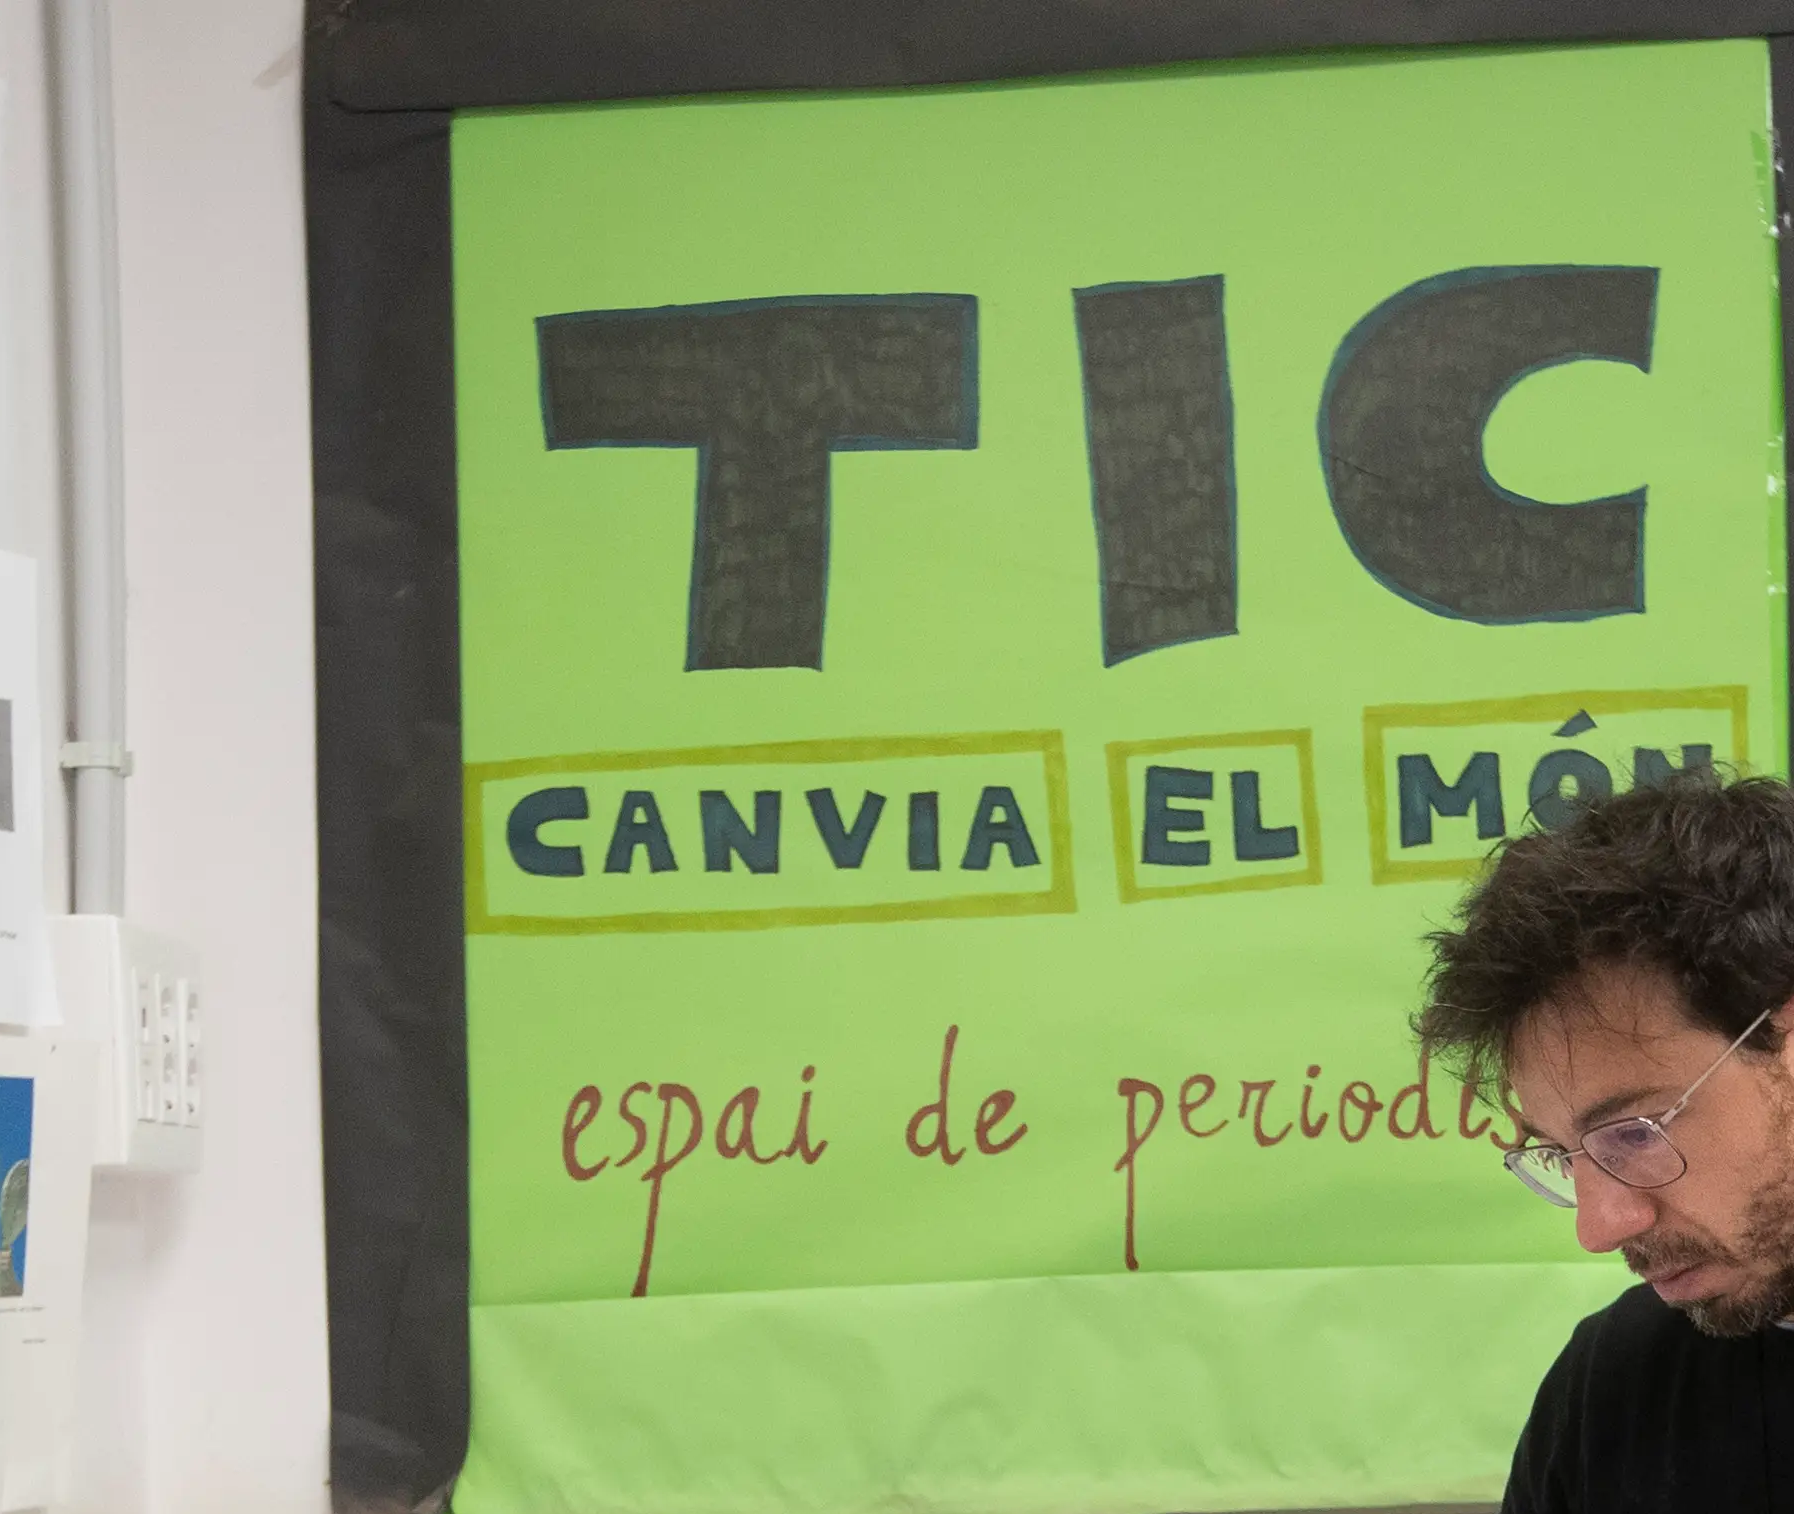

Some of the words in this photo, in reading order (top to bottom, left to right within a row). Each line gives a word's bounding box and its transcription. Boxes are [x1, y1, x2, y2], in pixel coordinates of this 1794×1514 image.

[535, 264, 1660, 672] TIC
[505, 785, 1042, 877] CANVIA
[1141, 766, 1301, 866] EL
[560, 1061, 828, 1298] espai
[905, 1025, 1027, 1163] de
[1114, 1028, 1530, 1271] periodis
